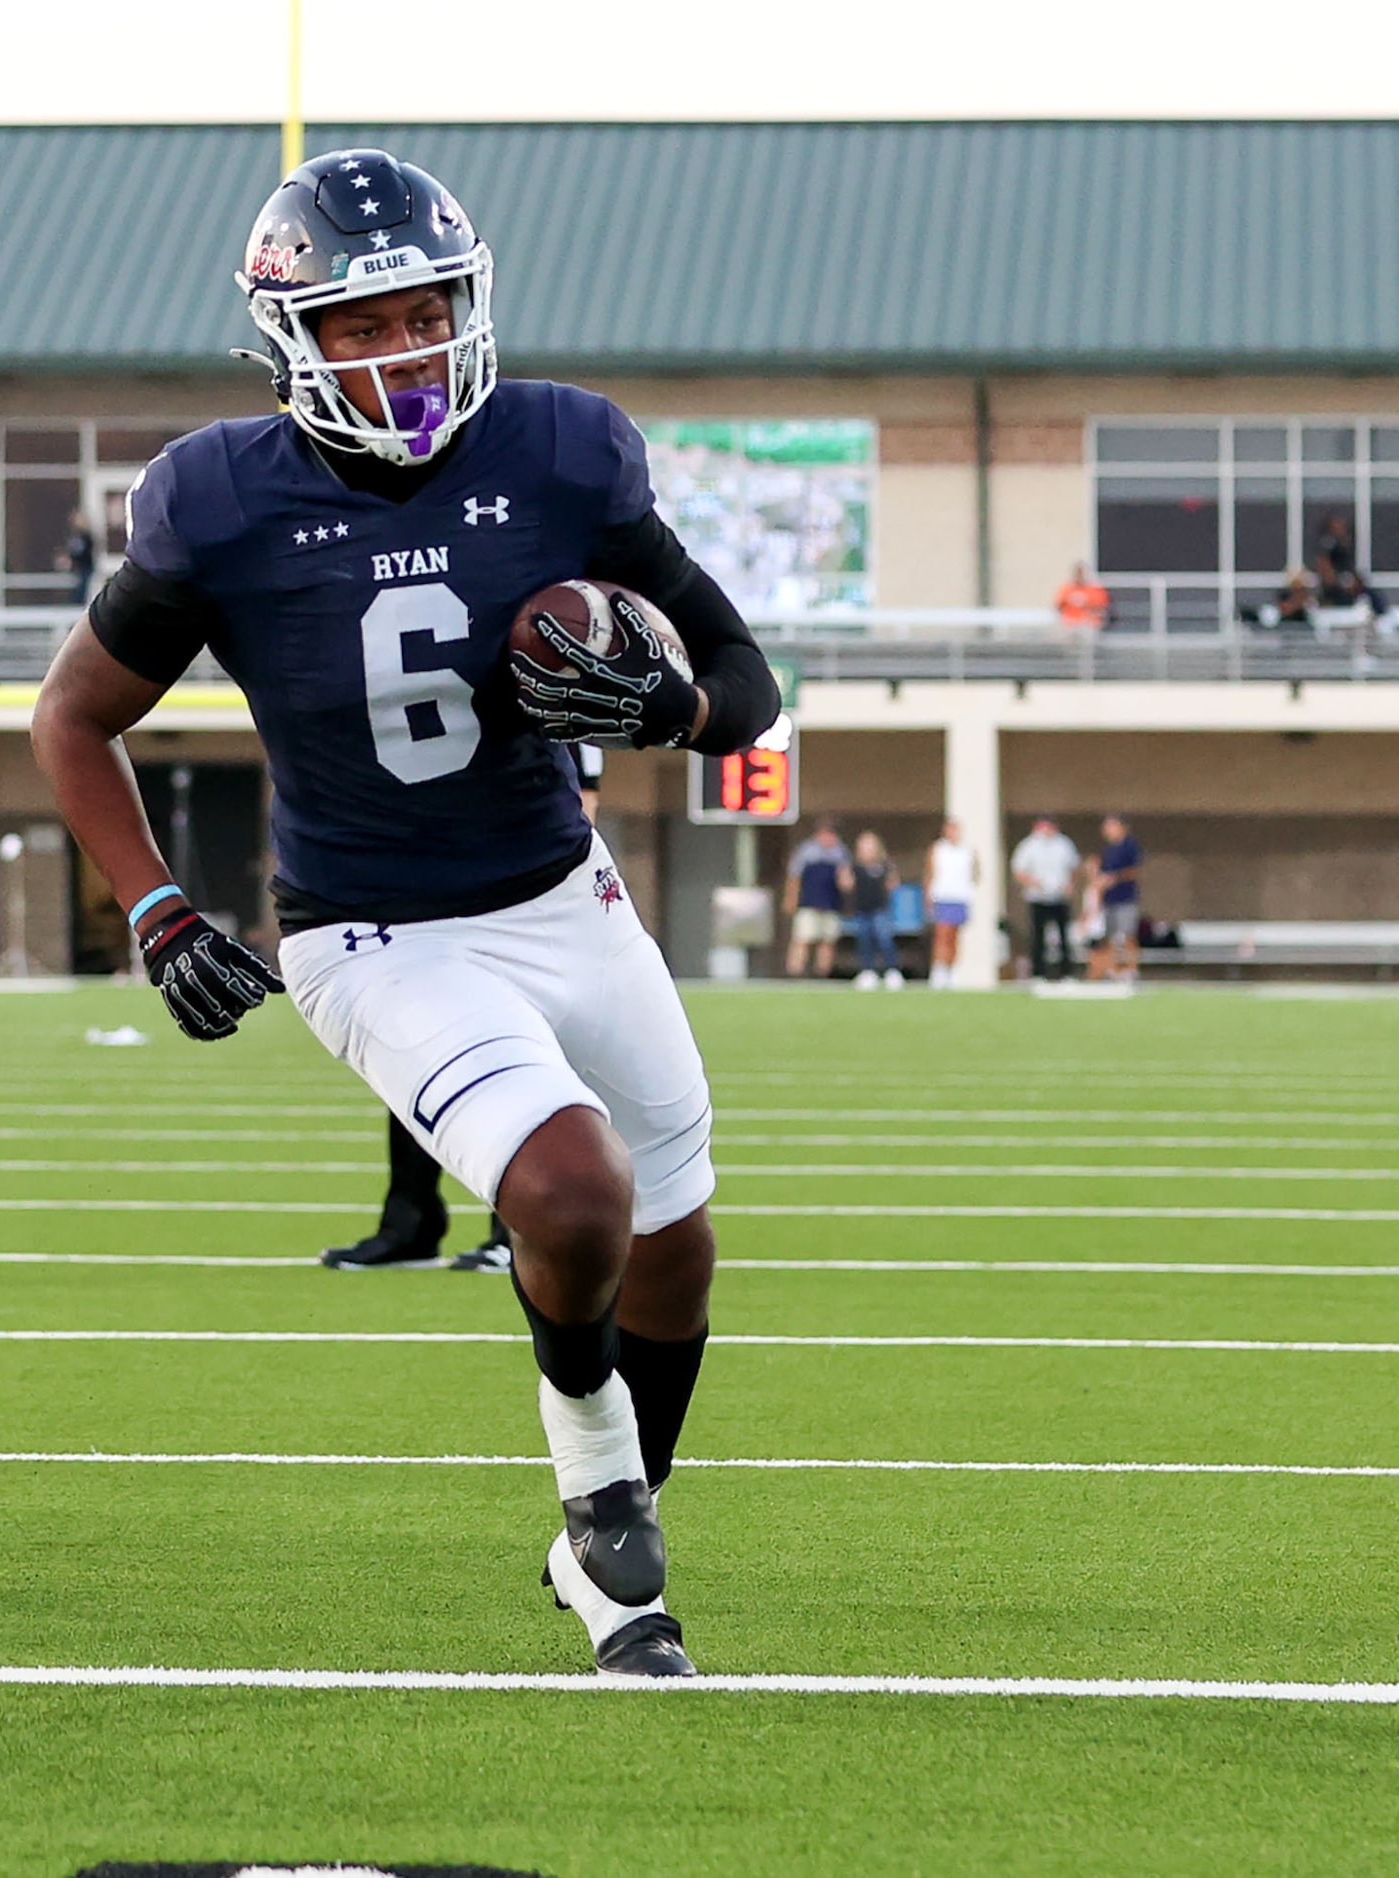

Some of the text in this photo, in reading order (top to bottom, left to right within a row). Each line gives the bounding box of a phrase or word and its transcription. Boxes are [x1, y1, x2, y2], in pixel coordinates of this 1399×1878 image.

[362, 252, 410, 275] BLUE
[371, 546, 450, 581] RYAN
[360, 582, 482, 785] 6
[721, 747, 789, 817] 13
